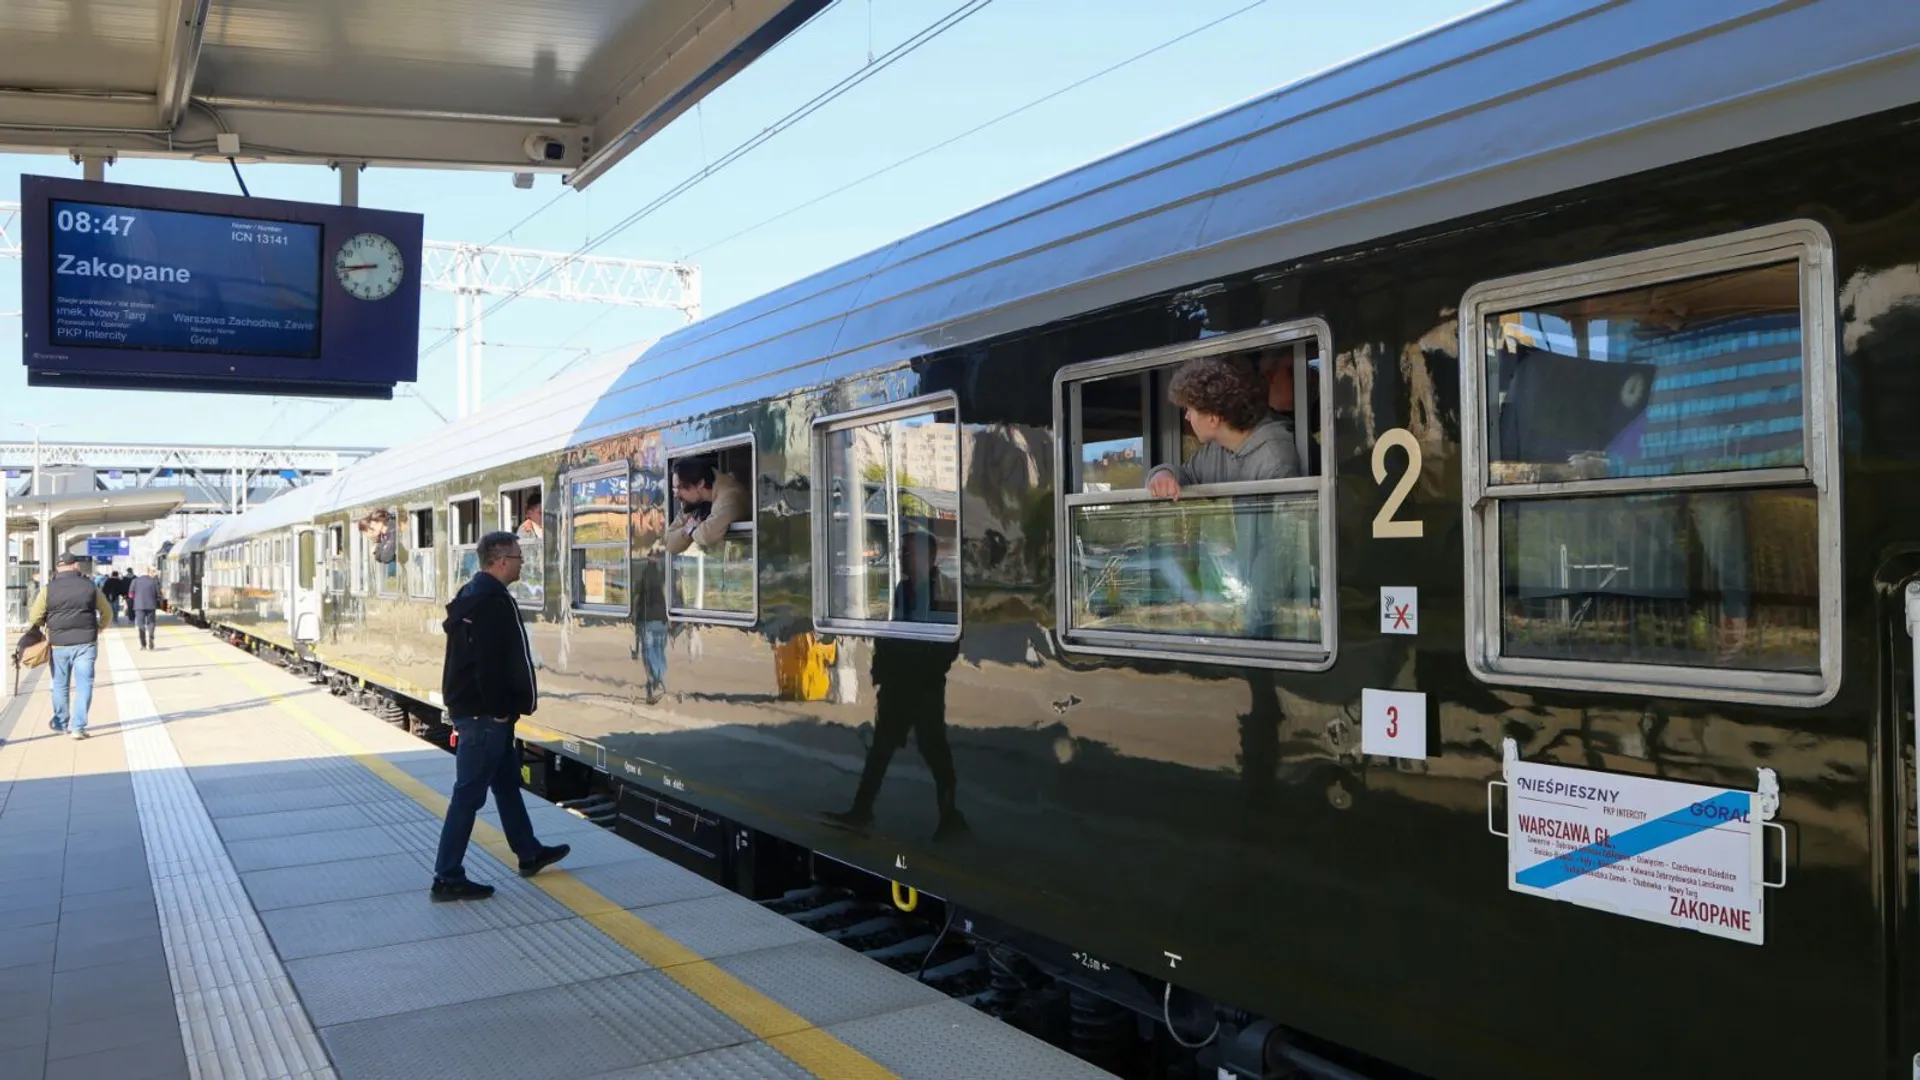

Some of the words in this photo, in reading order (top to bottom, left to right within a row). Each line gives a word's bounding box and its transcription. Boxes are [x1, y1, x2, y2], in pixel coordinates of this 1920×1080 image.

[58, 210, 136, 236] 08:47
[232, 232, 253, 242] ICN
[256, 234, 288, 245] 13141
[57, 254, 191, 284] Zakopane
[90, 307, 120, 321] Nowy
[123, 309, 146, 321] Targ
[173, 312, 226, 326] Warszawa
[57, 327, 82, 337] PKP
[85, 329, 127, 342] Intercity
[190, 334, 219, 346] Góral
[1371, 427, 1423, 538] 2
[1386, 705, 1398, 739] 3
[1517, 777, 1620, 804] NIEŚPIESZNY
[1690, 801, 1751, 824] GÓRAL
[1518, 813, 1591, 844] WARSZAWA
[1670, 896, 1751, 932] ZAKOPANE
